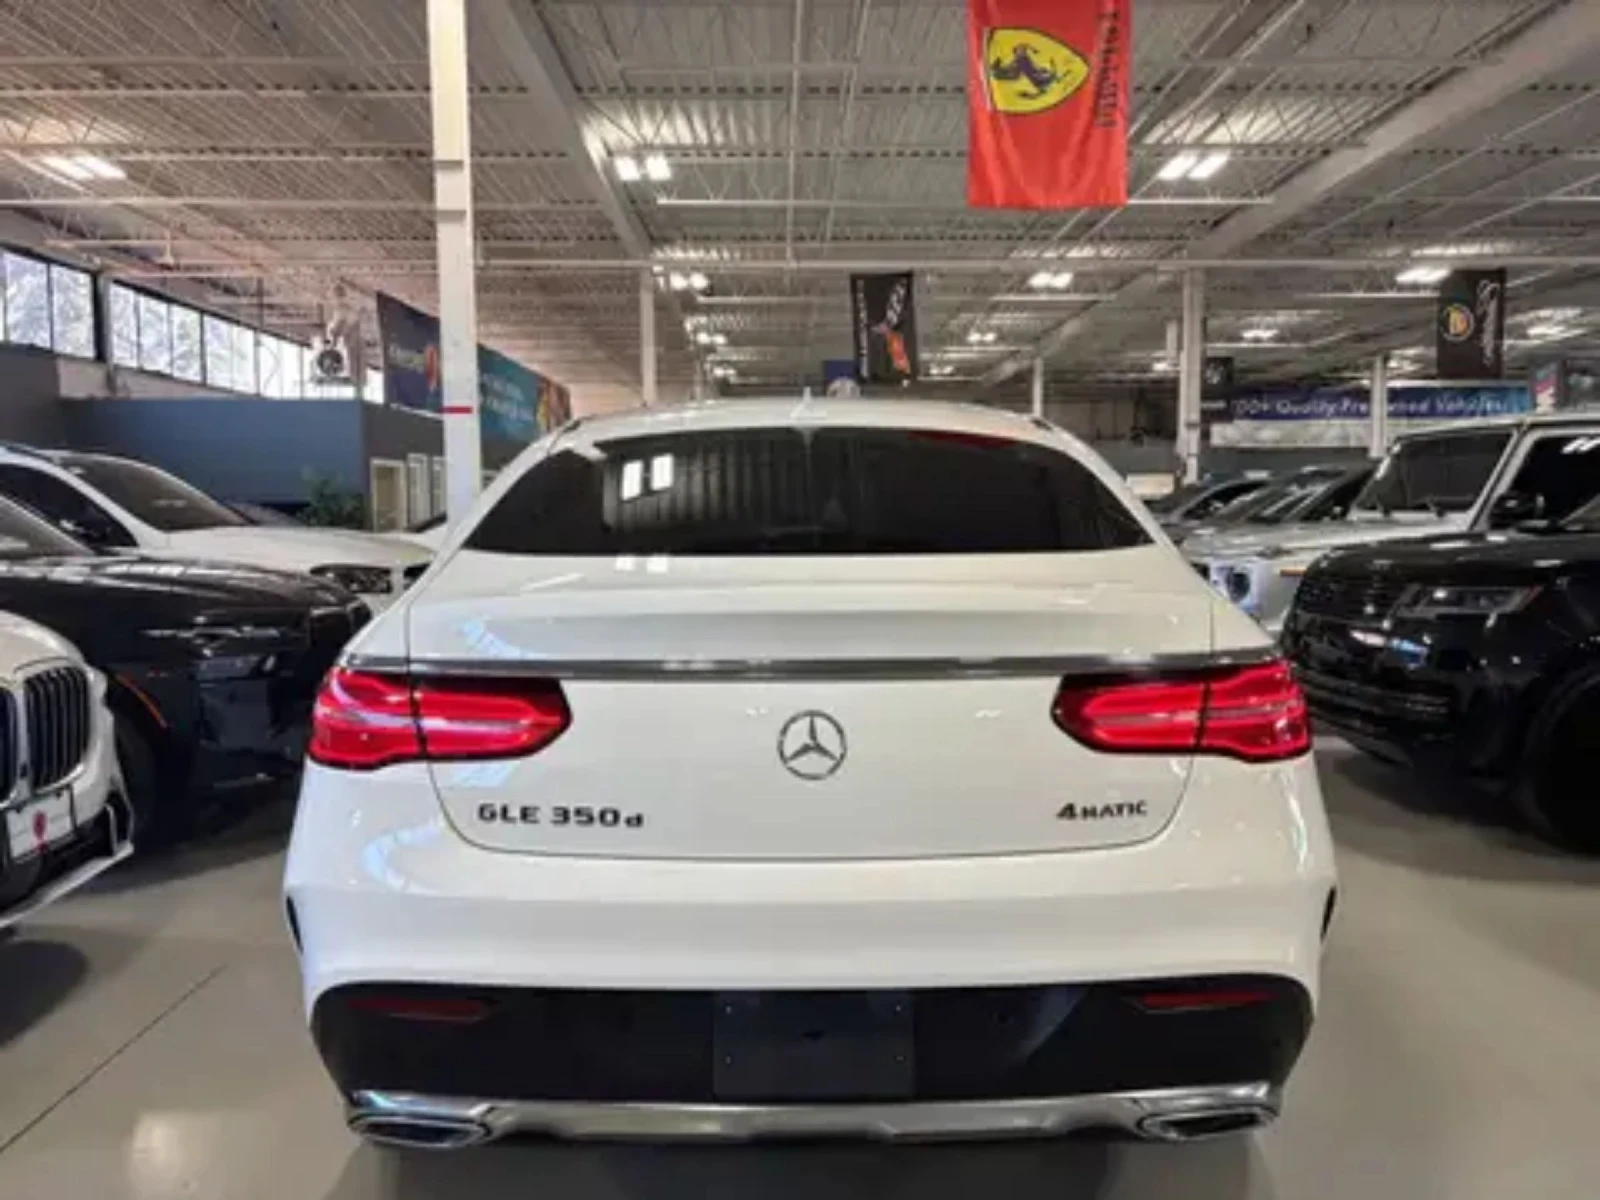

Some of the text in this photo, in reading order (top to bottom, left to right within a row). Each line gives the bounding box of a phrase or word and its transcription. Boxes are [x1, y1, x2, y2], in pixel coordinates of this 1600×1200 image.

[478, 802, 644, 828] GLE 350d
[1055, 799, 1148, 820] 4MATIC
